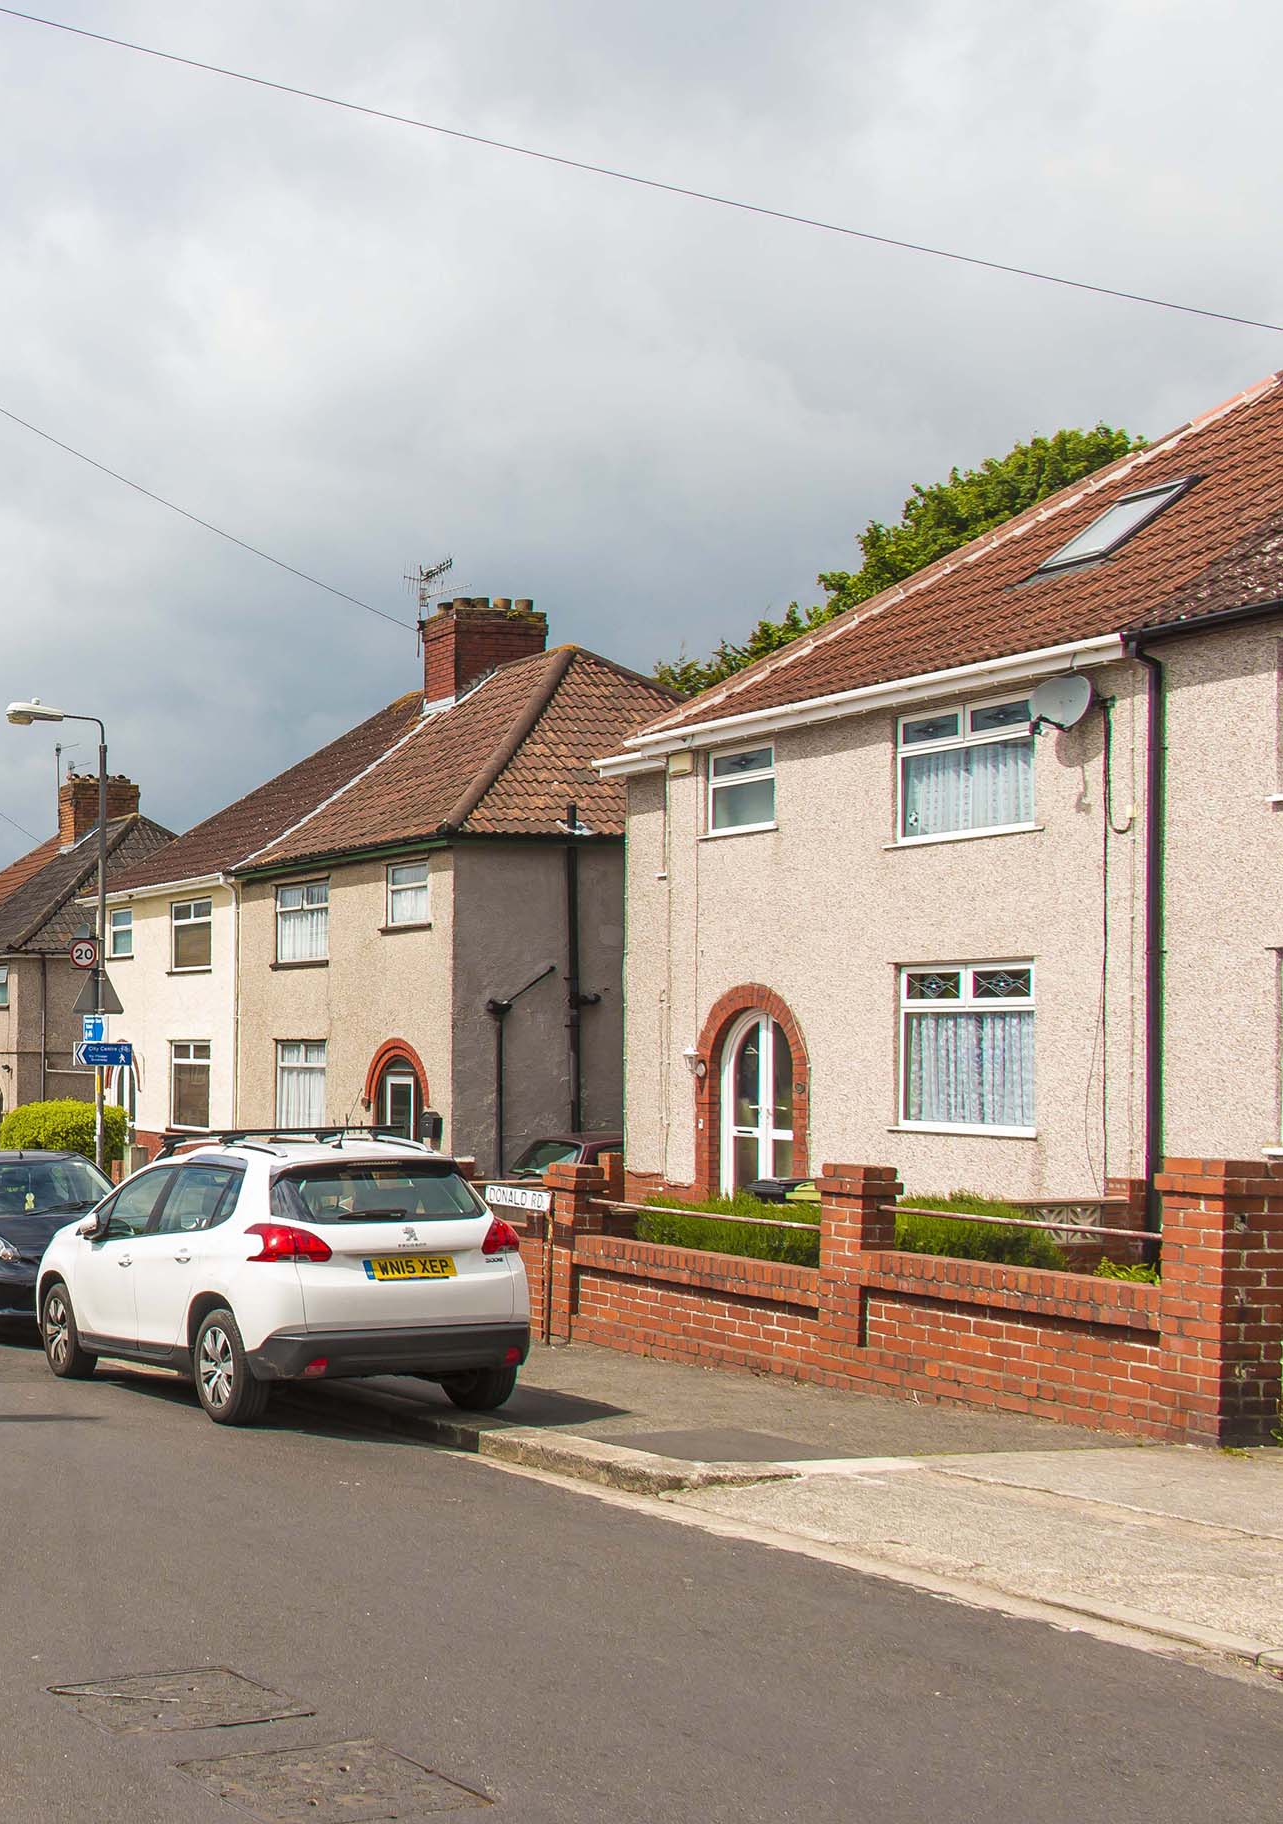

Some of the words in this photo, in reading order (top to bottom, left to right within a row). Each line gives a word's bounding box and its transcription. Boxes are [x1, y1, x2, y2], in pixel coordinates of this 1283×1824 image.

[75, 948, 93, 960] 20
[489, 1187, 527, 1206] DONALD
[530, 1193, 545, 1209] RD.
[377, 1260, 416, 1276] WN15
[418, 1258, 449, 1274] XEP
